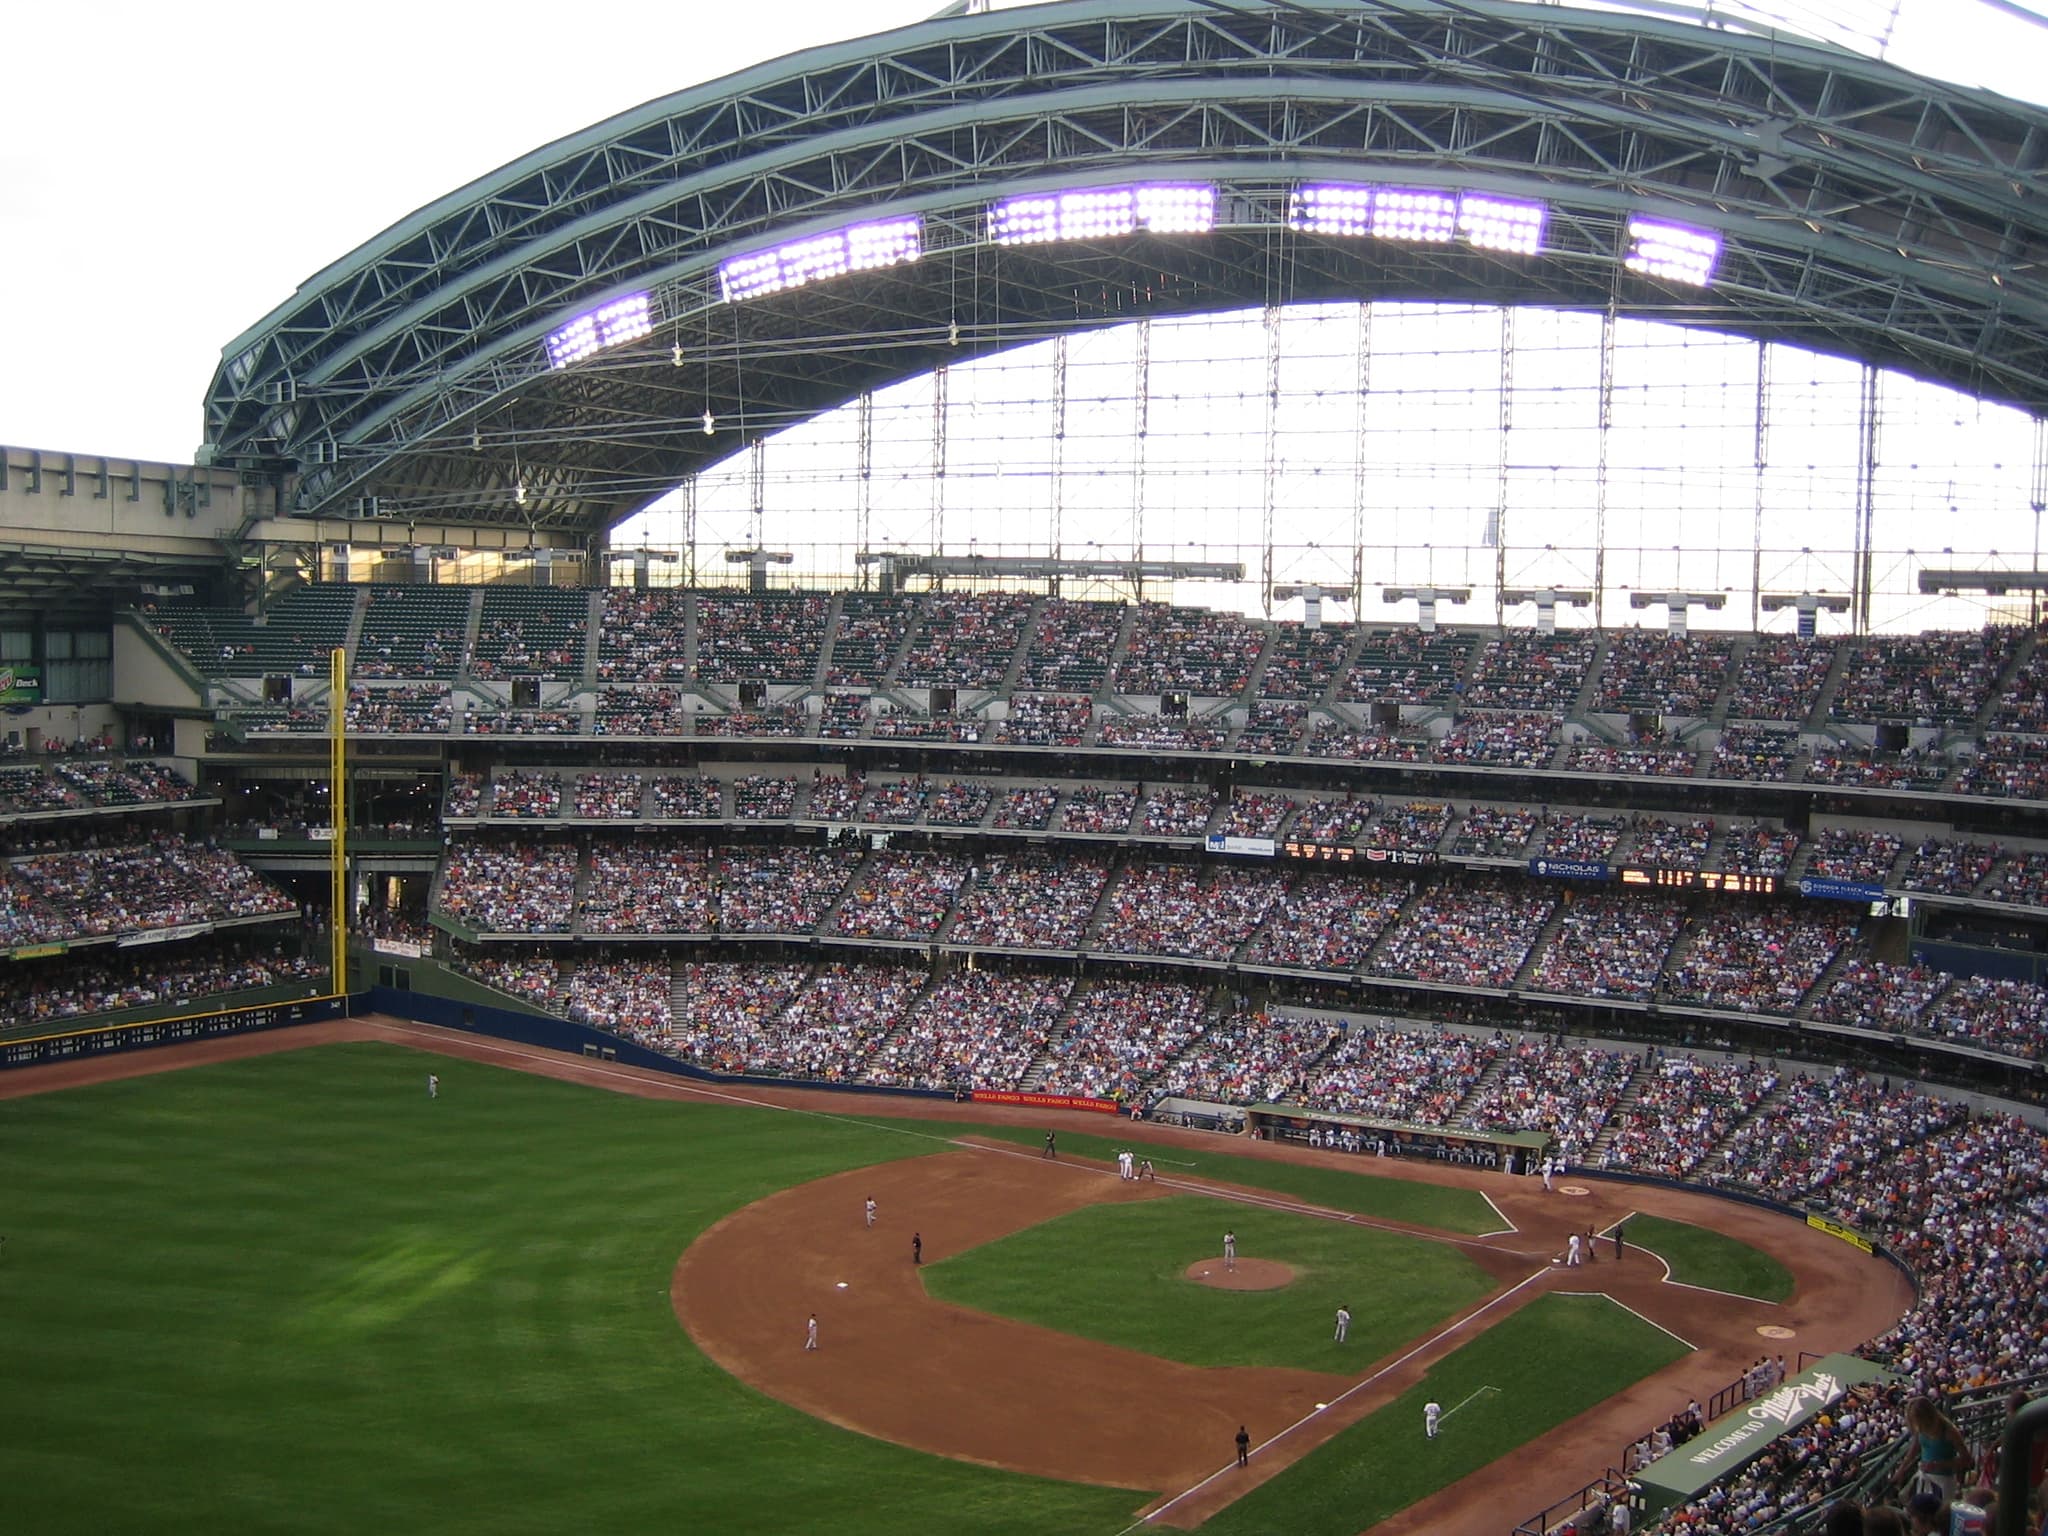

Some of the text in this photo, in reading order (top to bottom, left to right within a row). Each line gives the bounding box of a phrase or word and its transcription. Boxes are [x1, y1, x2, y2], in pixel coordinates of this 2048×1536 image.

[1548, 863, 1600, 873] NICHOLAS
[1072, 1099, 1094, 1107] WELLS
[1095, 1102, 1117, 1110] FARGO
[1689, 1372, 1841, 1464] WELCOME TO Miller Park
